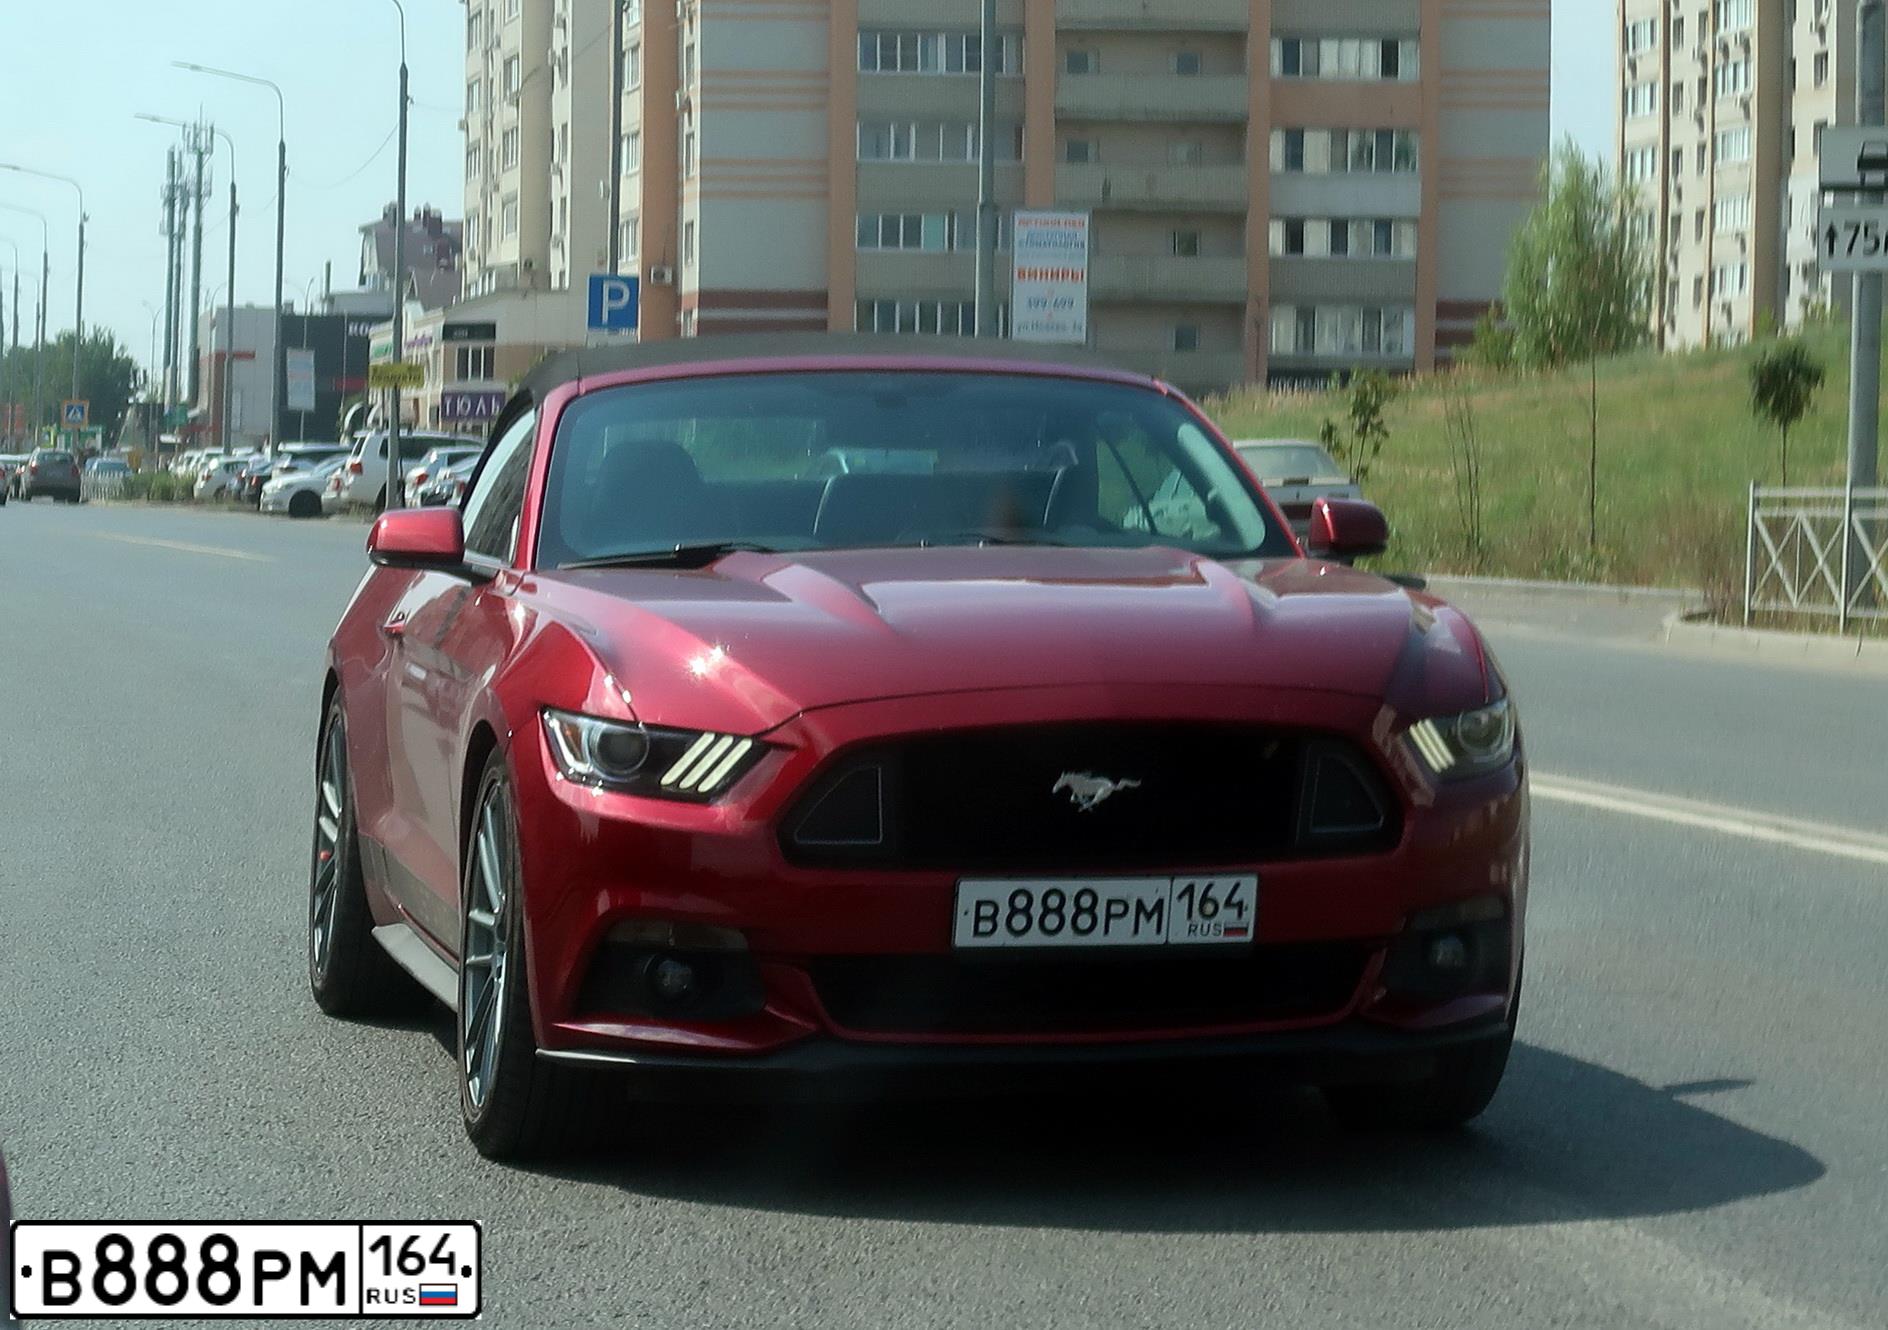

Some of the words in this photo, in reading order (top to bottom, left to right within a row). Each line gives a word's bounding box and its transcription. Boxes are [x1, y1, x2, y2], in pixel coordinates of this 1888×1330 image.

[1843, 219, 1888, 258] 75
[1018, 267, 1084, 282] ВИНИРЫ
[602, 280, 630, 325] P
[444, 394, 501, 416] ТЮЛЬ
[1176, 881, 1246, 921] 164
[1187, 923, 1223, 937] RUS
